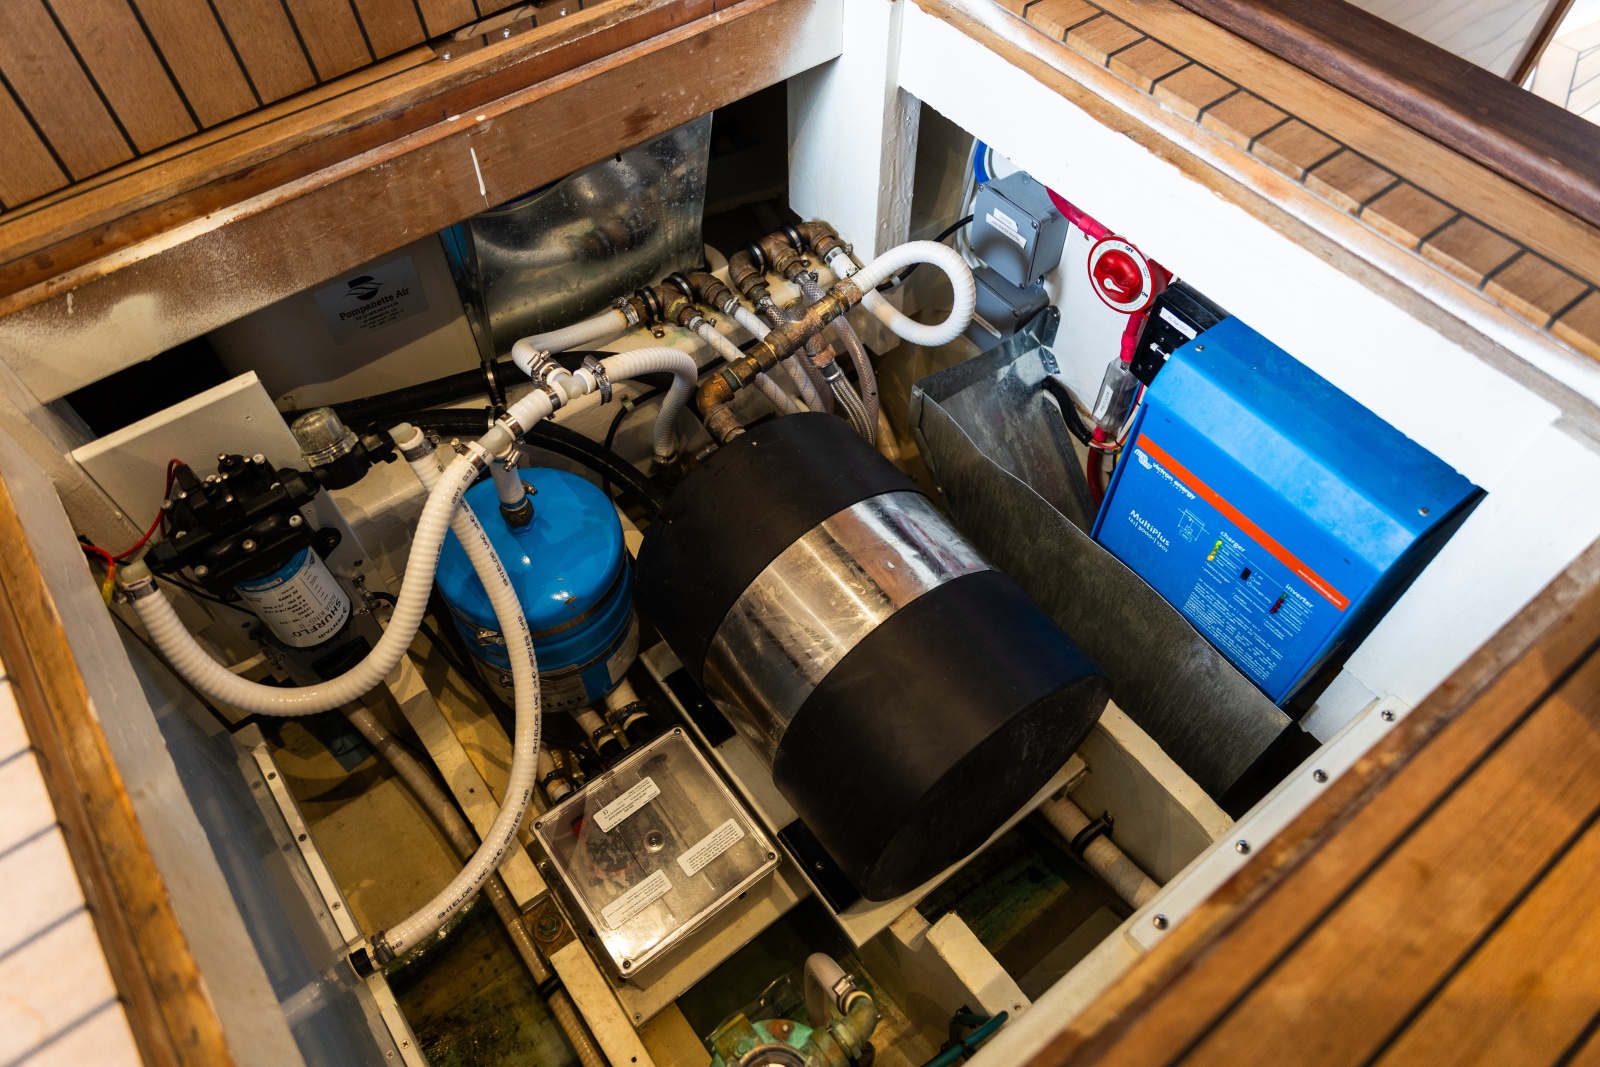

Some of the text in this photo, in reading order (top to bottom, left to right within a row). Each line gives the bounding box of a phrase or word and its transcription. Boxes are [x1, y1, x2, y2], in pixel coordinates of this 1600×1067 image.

[338, 294, 394, 321] Pompanette
[397, 288, 410, 298] Air
[1153, 462, 1174, 482] victron
[1173, 480, 1196, 499] energy
[469, 515, 481, 531] XHD
[1130, 509, 1171, 546] MultiPlus
[479, 534, 490, 549] VAC
[1220, 531, 1246, 553] charger
[489, 552, 509, 587] SHIELDS
[325, 593, 336, 611] AQUA
[1285, 583, 1314, 609] inverter
[293, 598, 341, 638] SHURFLO
[308, 611, 326, 625] KING
[318, 615, 344, 639] PENTAIR
[524, 635, 535, 668] SERIES
[437, 886, 473, 919] SHIELDS
[474, 868, 489, 884] VAC
[490, 848, 503, 865] XHD
[503, 810, 522, 845] SERIES
